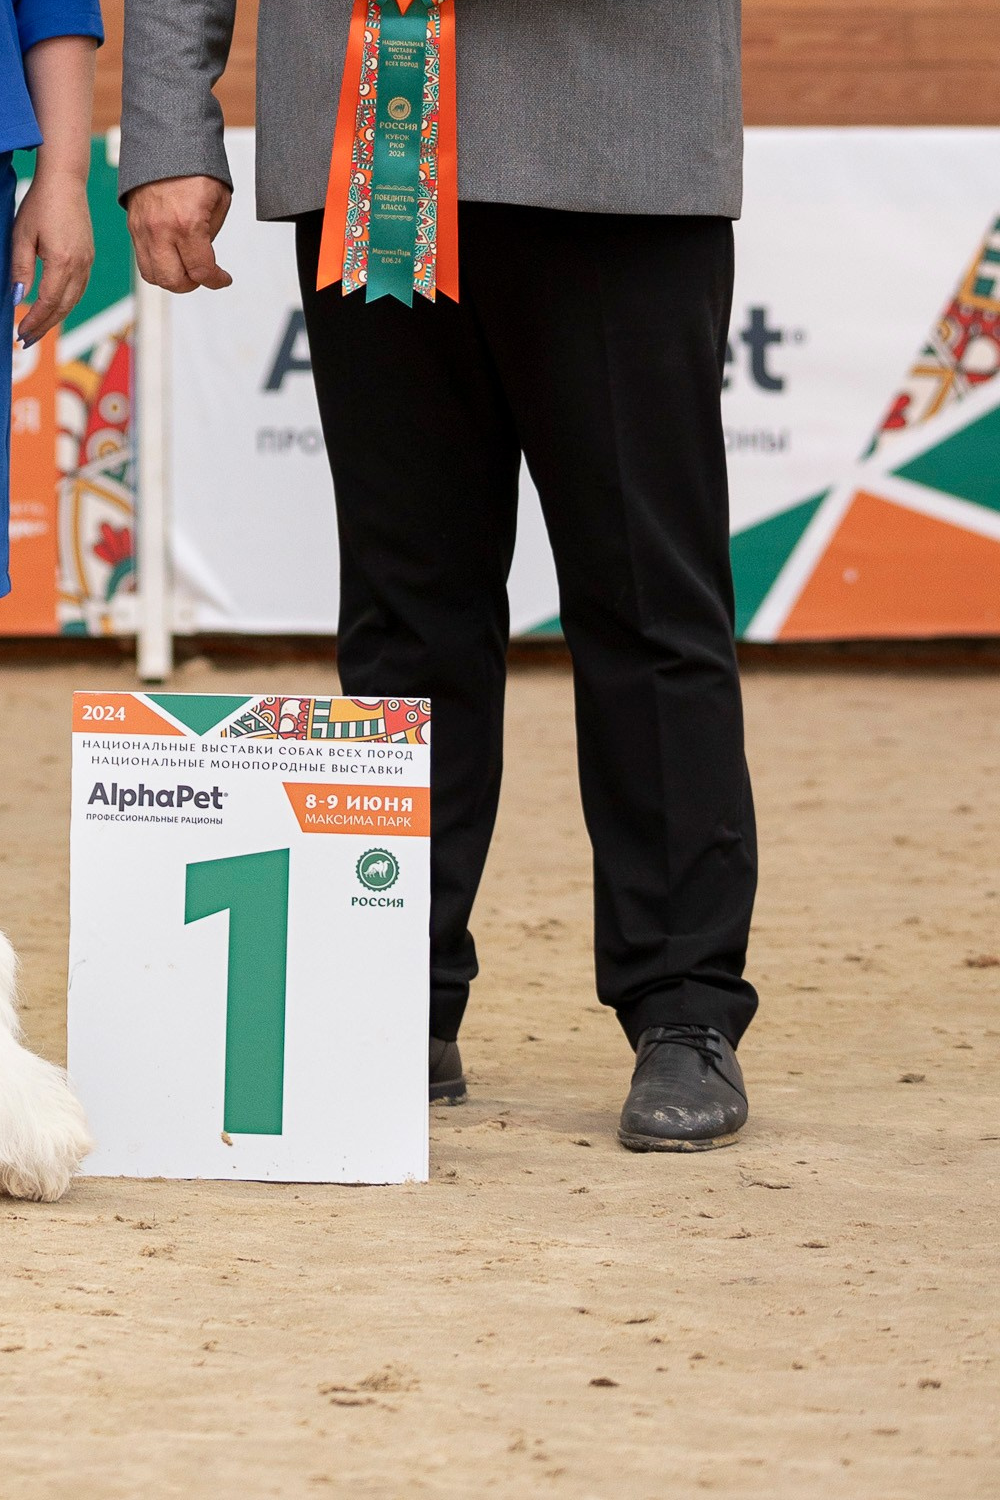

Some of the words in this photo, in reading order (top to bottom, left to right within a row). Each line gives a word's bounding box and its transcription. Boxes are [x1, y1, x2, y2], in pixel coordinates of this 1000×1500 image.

[400, 61, 419, 69] ПОРОД
[379, 121, 418, 131] РОССИЯ
[385, 133, 410, 141] КУБОК
[374, 193, 415, 203] ПОБЕДИТЕЛЬ
[381, 203, 407, 211] КЛАССА
[81, 705, 127, 721] 2024
[82, 739, 196, 753] НАЦИОНАЛЬНЫЕ
[201, 743, 273, 755] ВЫСТАВКИ
[278, 746, 323, 757] СОБАК
[328, 749, 362, 758] ВСЕХ
[367, 749, 413, 761] ПОРОД
[91, 755, 205, 768] НАЦИОНАЛЬНЫЕ
[210, 759, 326, 773] МОНОПОРОДНЫЕ
[331, 763, 404, 775] ВЫСТАВКИ
[87, 782, 223, 812] AlphaPet
[305, 793, 339, 809] 8-9
[346, 795, 413, 812] ИЮНЯ
[86, 813, 179, 824] ПРОФЕССИОНАЛЬНЫЕ
[180, 816, 223, 826] РАЦИОНЫ
[304, 813, 374, 826] МАКСИМА
[377, 815, 412, 827] ПАРК
[351, 896, 404, 908] РОССИЯ
[184, 847, 291, 1136] 1
